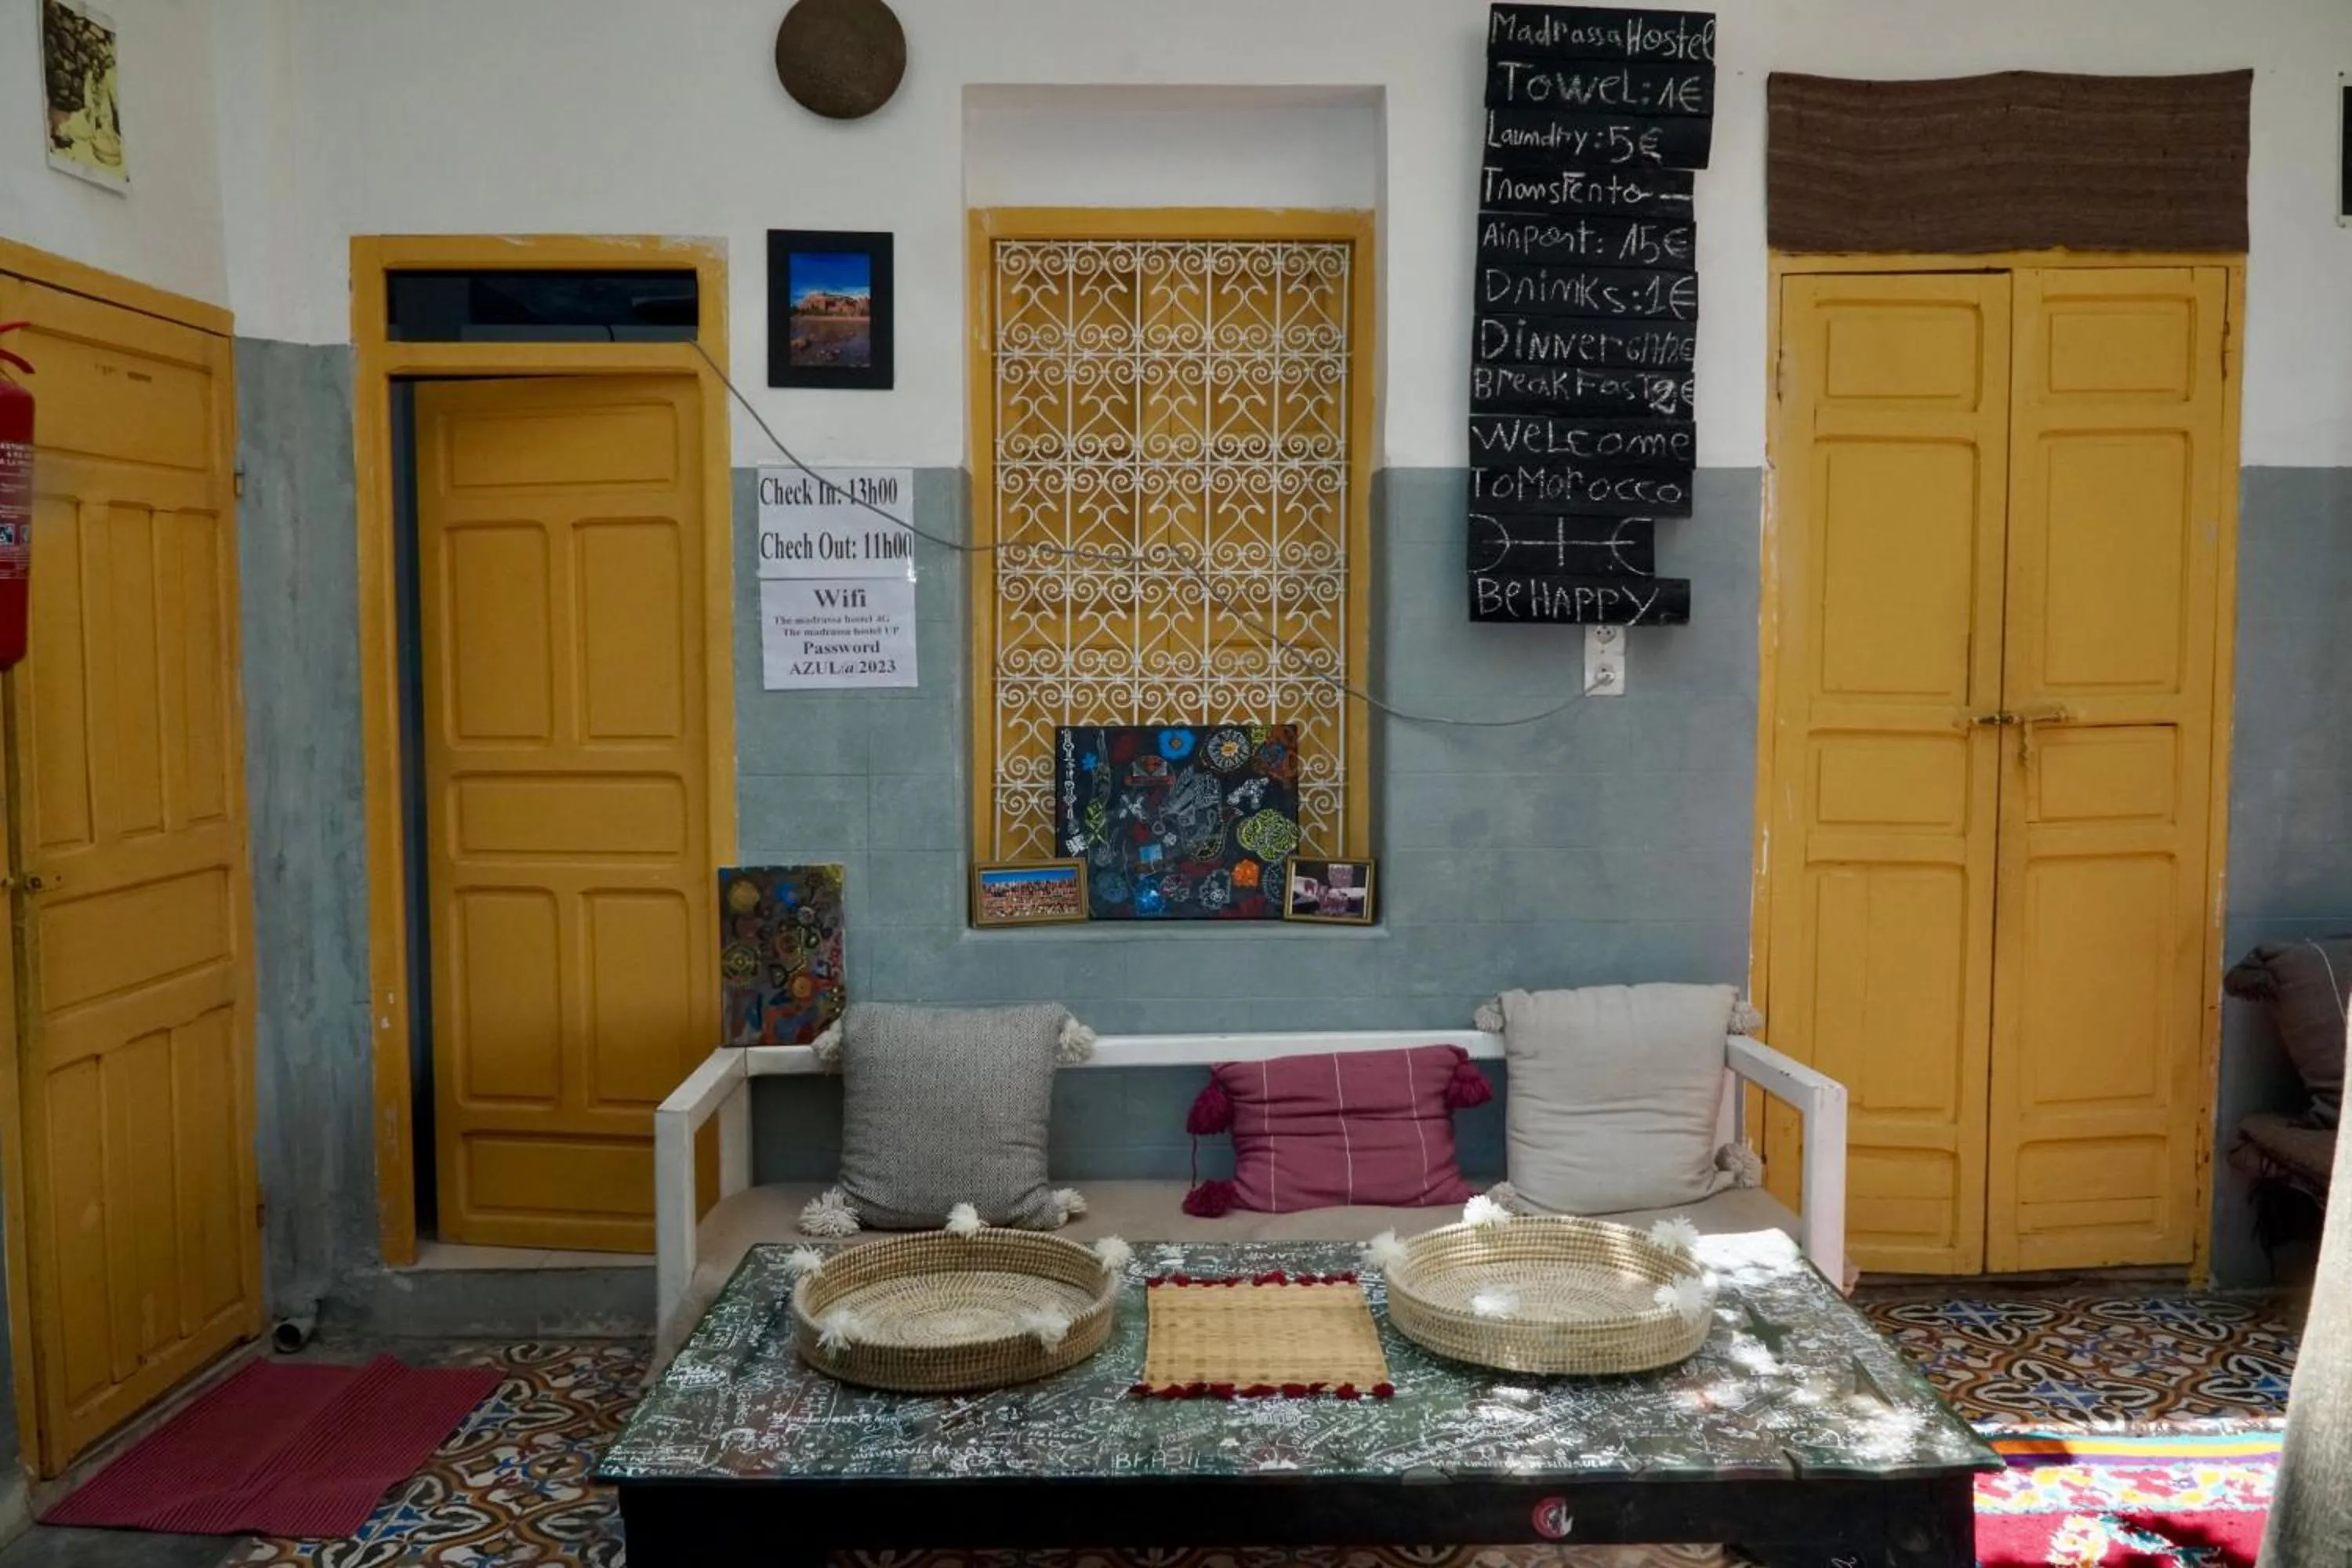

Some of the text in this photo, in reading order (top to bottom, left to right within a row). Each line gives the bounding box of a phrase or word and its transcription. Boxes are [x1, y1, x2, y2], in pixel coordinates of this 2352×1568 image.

[1625, 16, 1715, 60] Hostel
[1618, 222, 1688, 263] 15€
[1644, 274, 1697, 320] 1€
[760, 477, 898, 506] Check In: 13h00
[760, 531, 912, 560] Chech Out: 11h00
[813, 589, 867, 608] Wifi
[804, 640, 880, 655] Password
